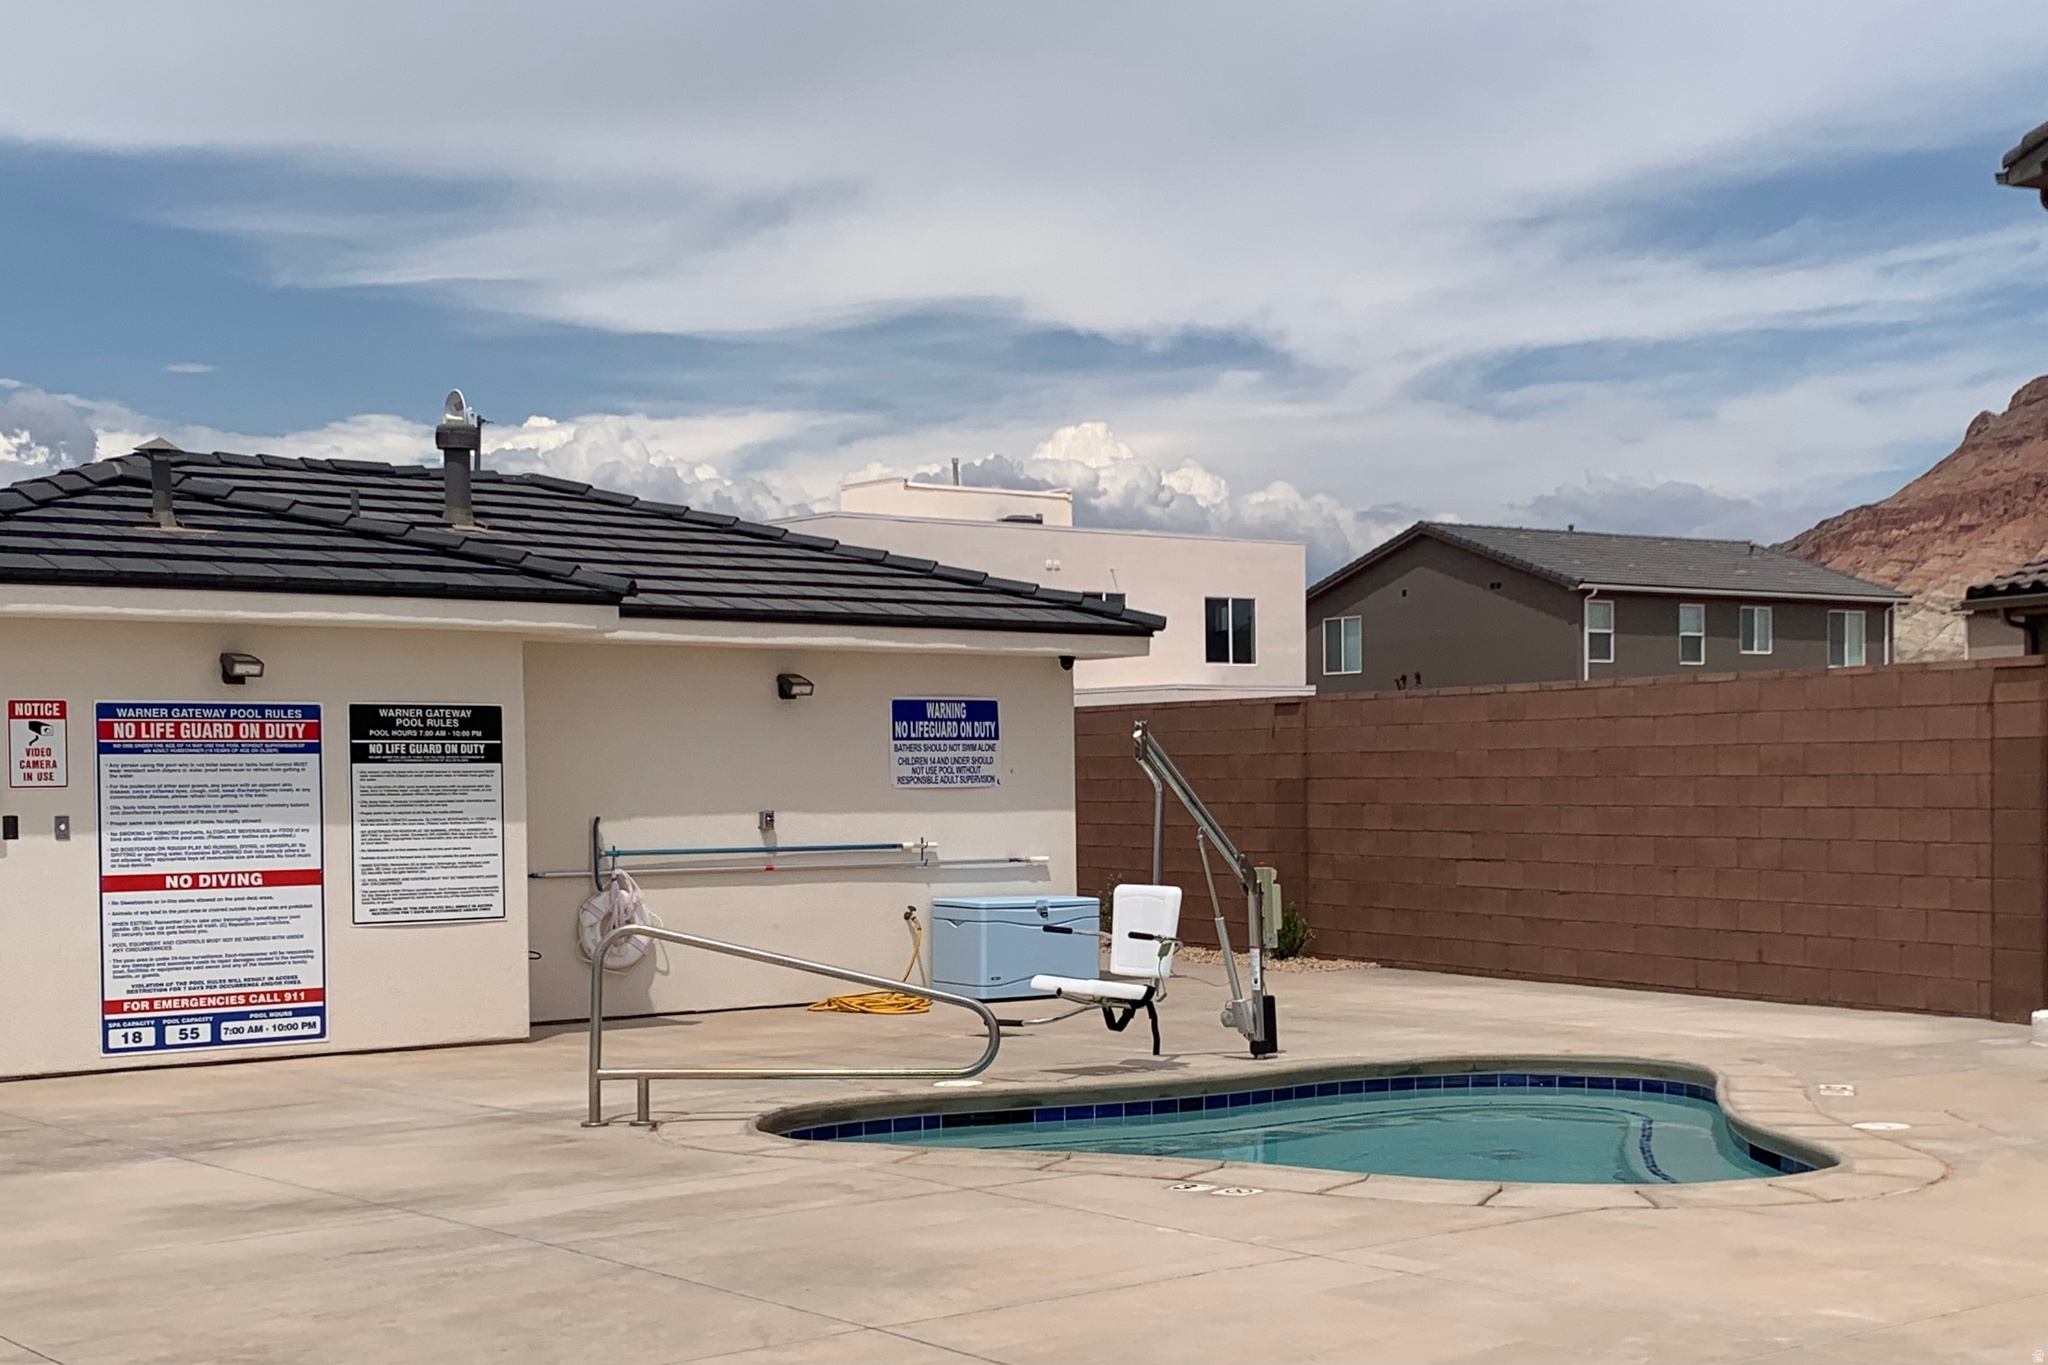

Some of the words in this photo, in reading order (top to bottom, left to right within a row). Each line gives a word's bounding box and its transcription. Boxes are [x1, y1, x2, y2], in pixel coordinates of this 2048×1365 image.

[15, 703, 60, 716] NOTICE
[117, 708, 168, 718] WARNER
[171, 708, 227, 719] GATEWAY
[230, 708, 261, 719] POOL
[265, 709, 302, 719] RULES
[379, 709, 423, 717] WARNER
[426, 709, 472, 717] GATEWAY
[926, 702, 966, 719] WARNING
[396, 719, 424, 727] POOL
[427, 719, 459, 727] RULES
[114, 723, 135, 738] NO
[141, 723, 175, 738] LIFE
[180, 723, 234, 738] GUARD
[239, 724, 260, 738] ON
[265, 724, 306, 739] DUTY
[895, 722, 908, 737] NO
[910, 721, 958, 738] LIFEGUARD
[960, 722, 972, 738] ON
[974, 722, 996, 738] DUTY
[25, 748, 52, 757] VIDEO
[369, 744, 382, 754] NO
[385, 744, 406, 754] LIFE
[409, 744, 442, 754] GUARD
[445, 744, 458, 754] ON
[461, 744, 485, 754] DUTY
[20, 760, 57, 769] CAMERA
[898, 757, 928, 765] CHILDREN
[951, 756, 970, 765] UNDER
[971, 756, 994, 764] SHOULD
[23, 773, 32, 781] IN
[37, 772, 54, 781] USE
[897, 776, 939, 784] RESPONSIBLE
[960, 776, 995, 784] SUPERVISION
[165, 875, 192, 888] NO
[198, 873, 263, 887] DIVING
[123, 1001, 150, 1011] FOR
[154, 996, 246, 1010] EMERGENCIES
[249, 993, 280, 1003] CALL
[284, 992, 305, 1001] 911
[179, 1028, 200, 1040] 55
[223, 1027, 244, 1035] 7:00
[247, 1025, 263, 1033] AM
[272, 1023, 298, 1032] 10:00
[122, 1031, 142, 1044] 18
